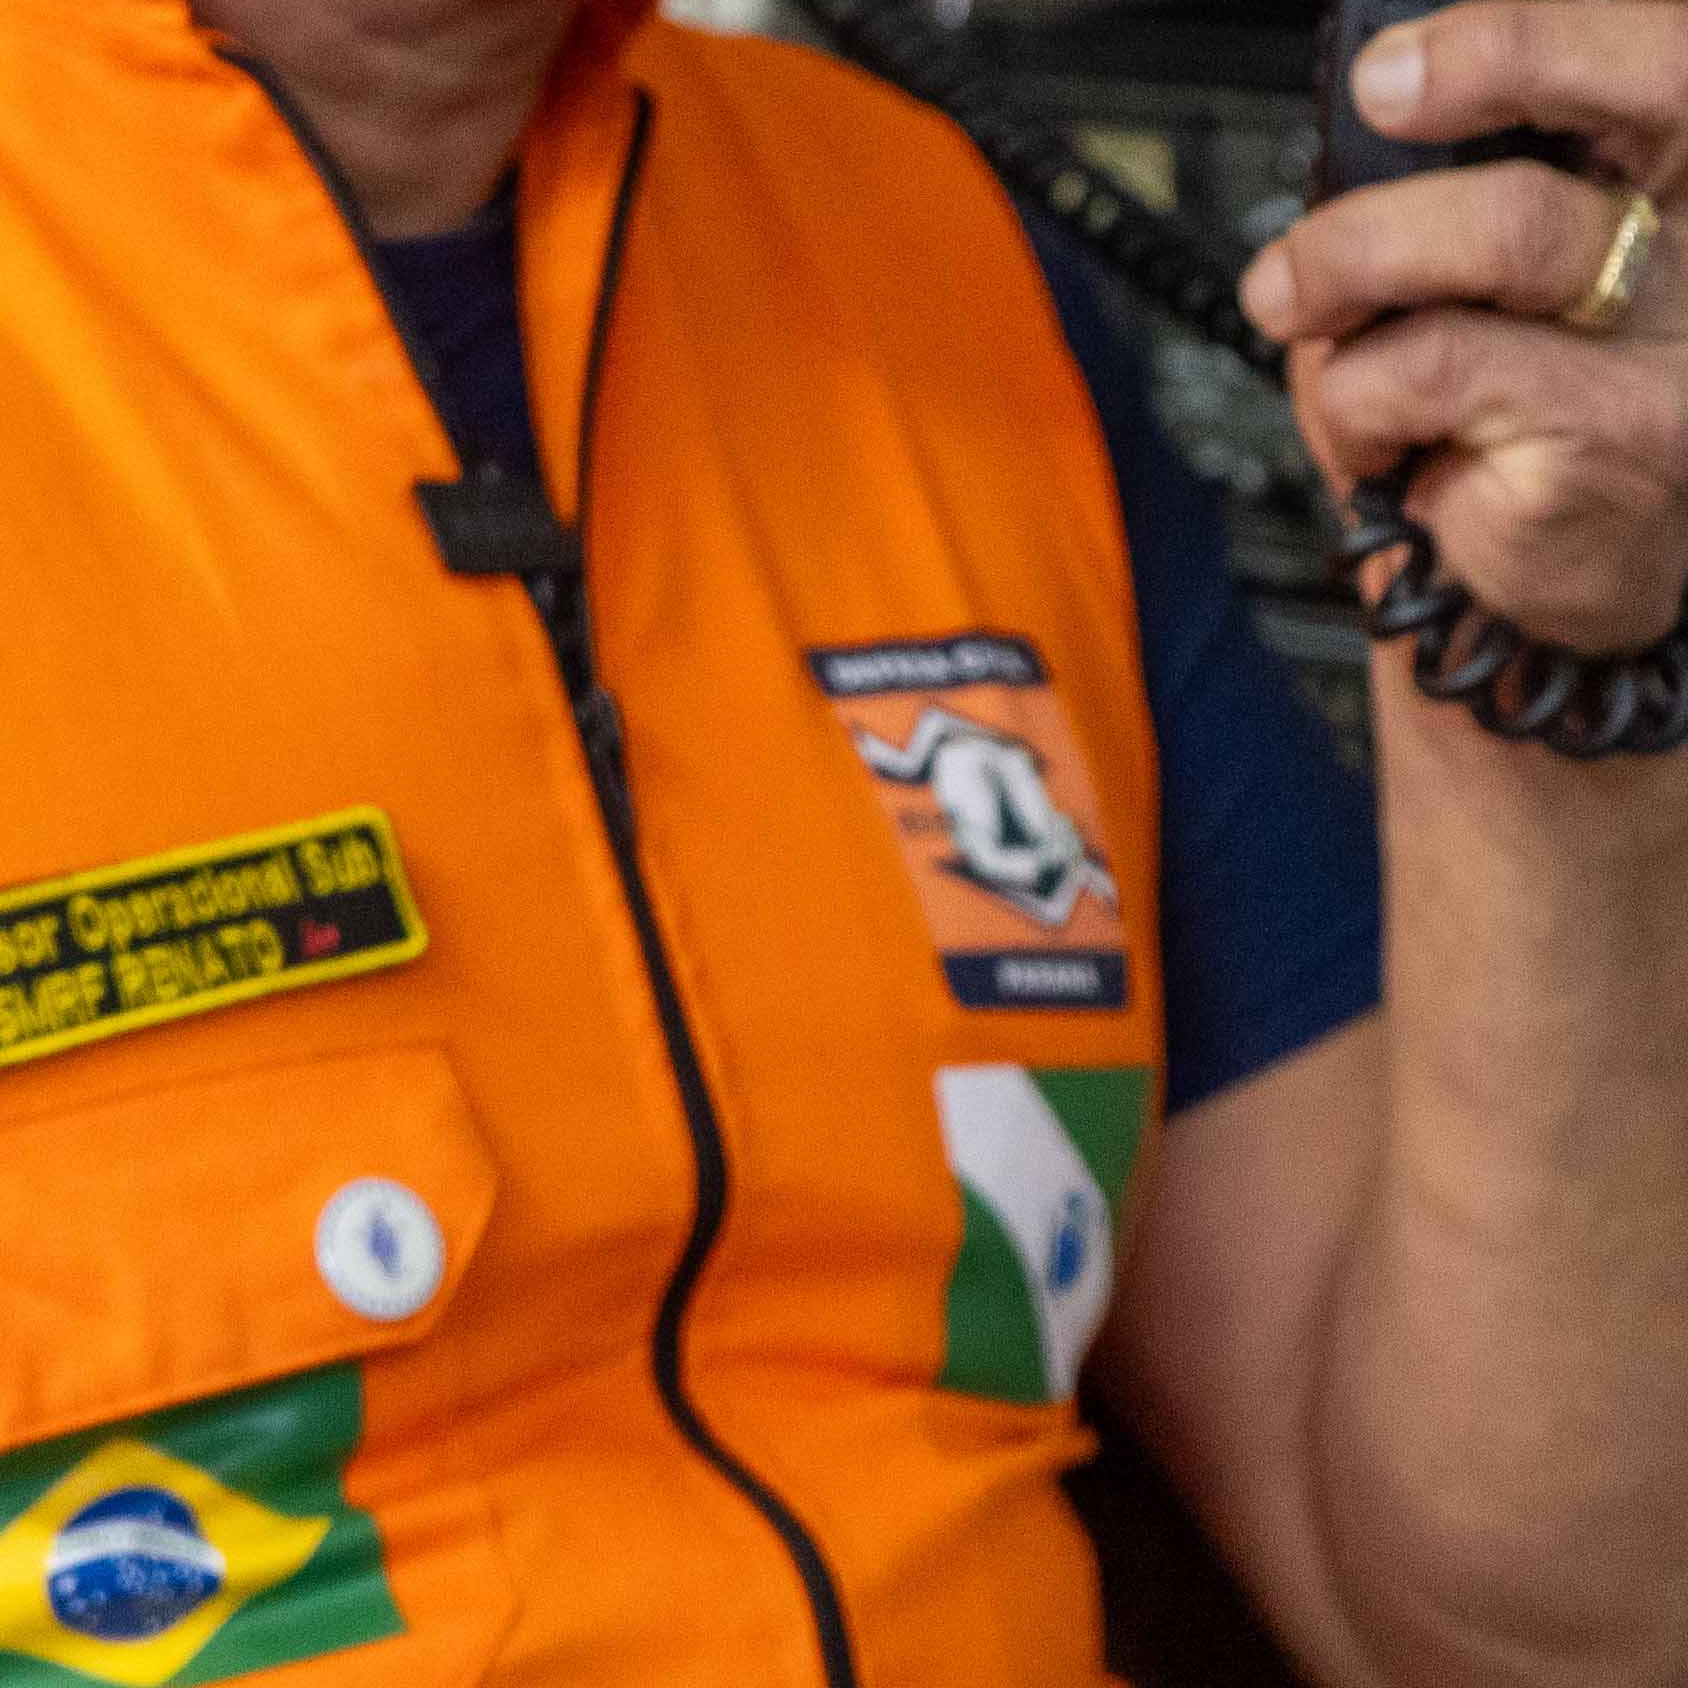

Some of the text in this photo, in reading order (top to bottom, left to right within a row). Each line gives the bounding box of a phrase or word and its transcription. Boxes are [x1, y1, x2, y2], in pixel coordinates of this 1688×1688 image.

[66, 849, 301, 953] Operacional
[297, 833, 380, 897] Sub
[114, 919, 284, 1013] RENATO
